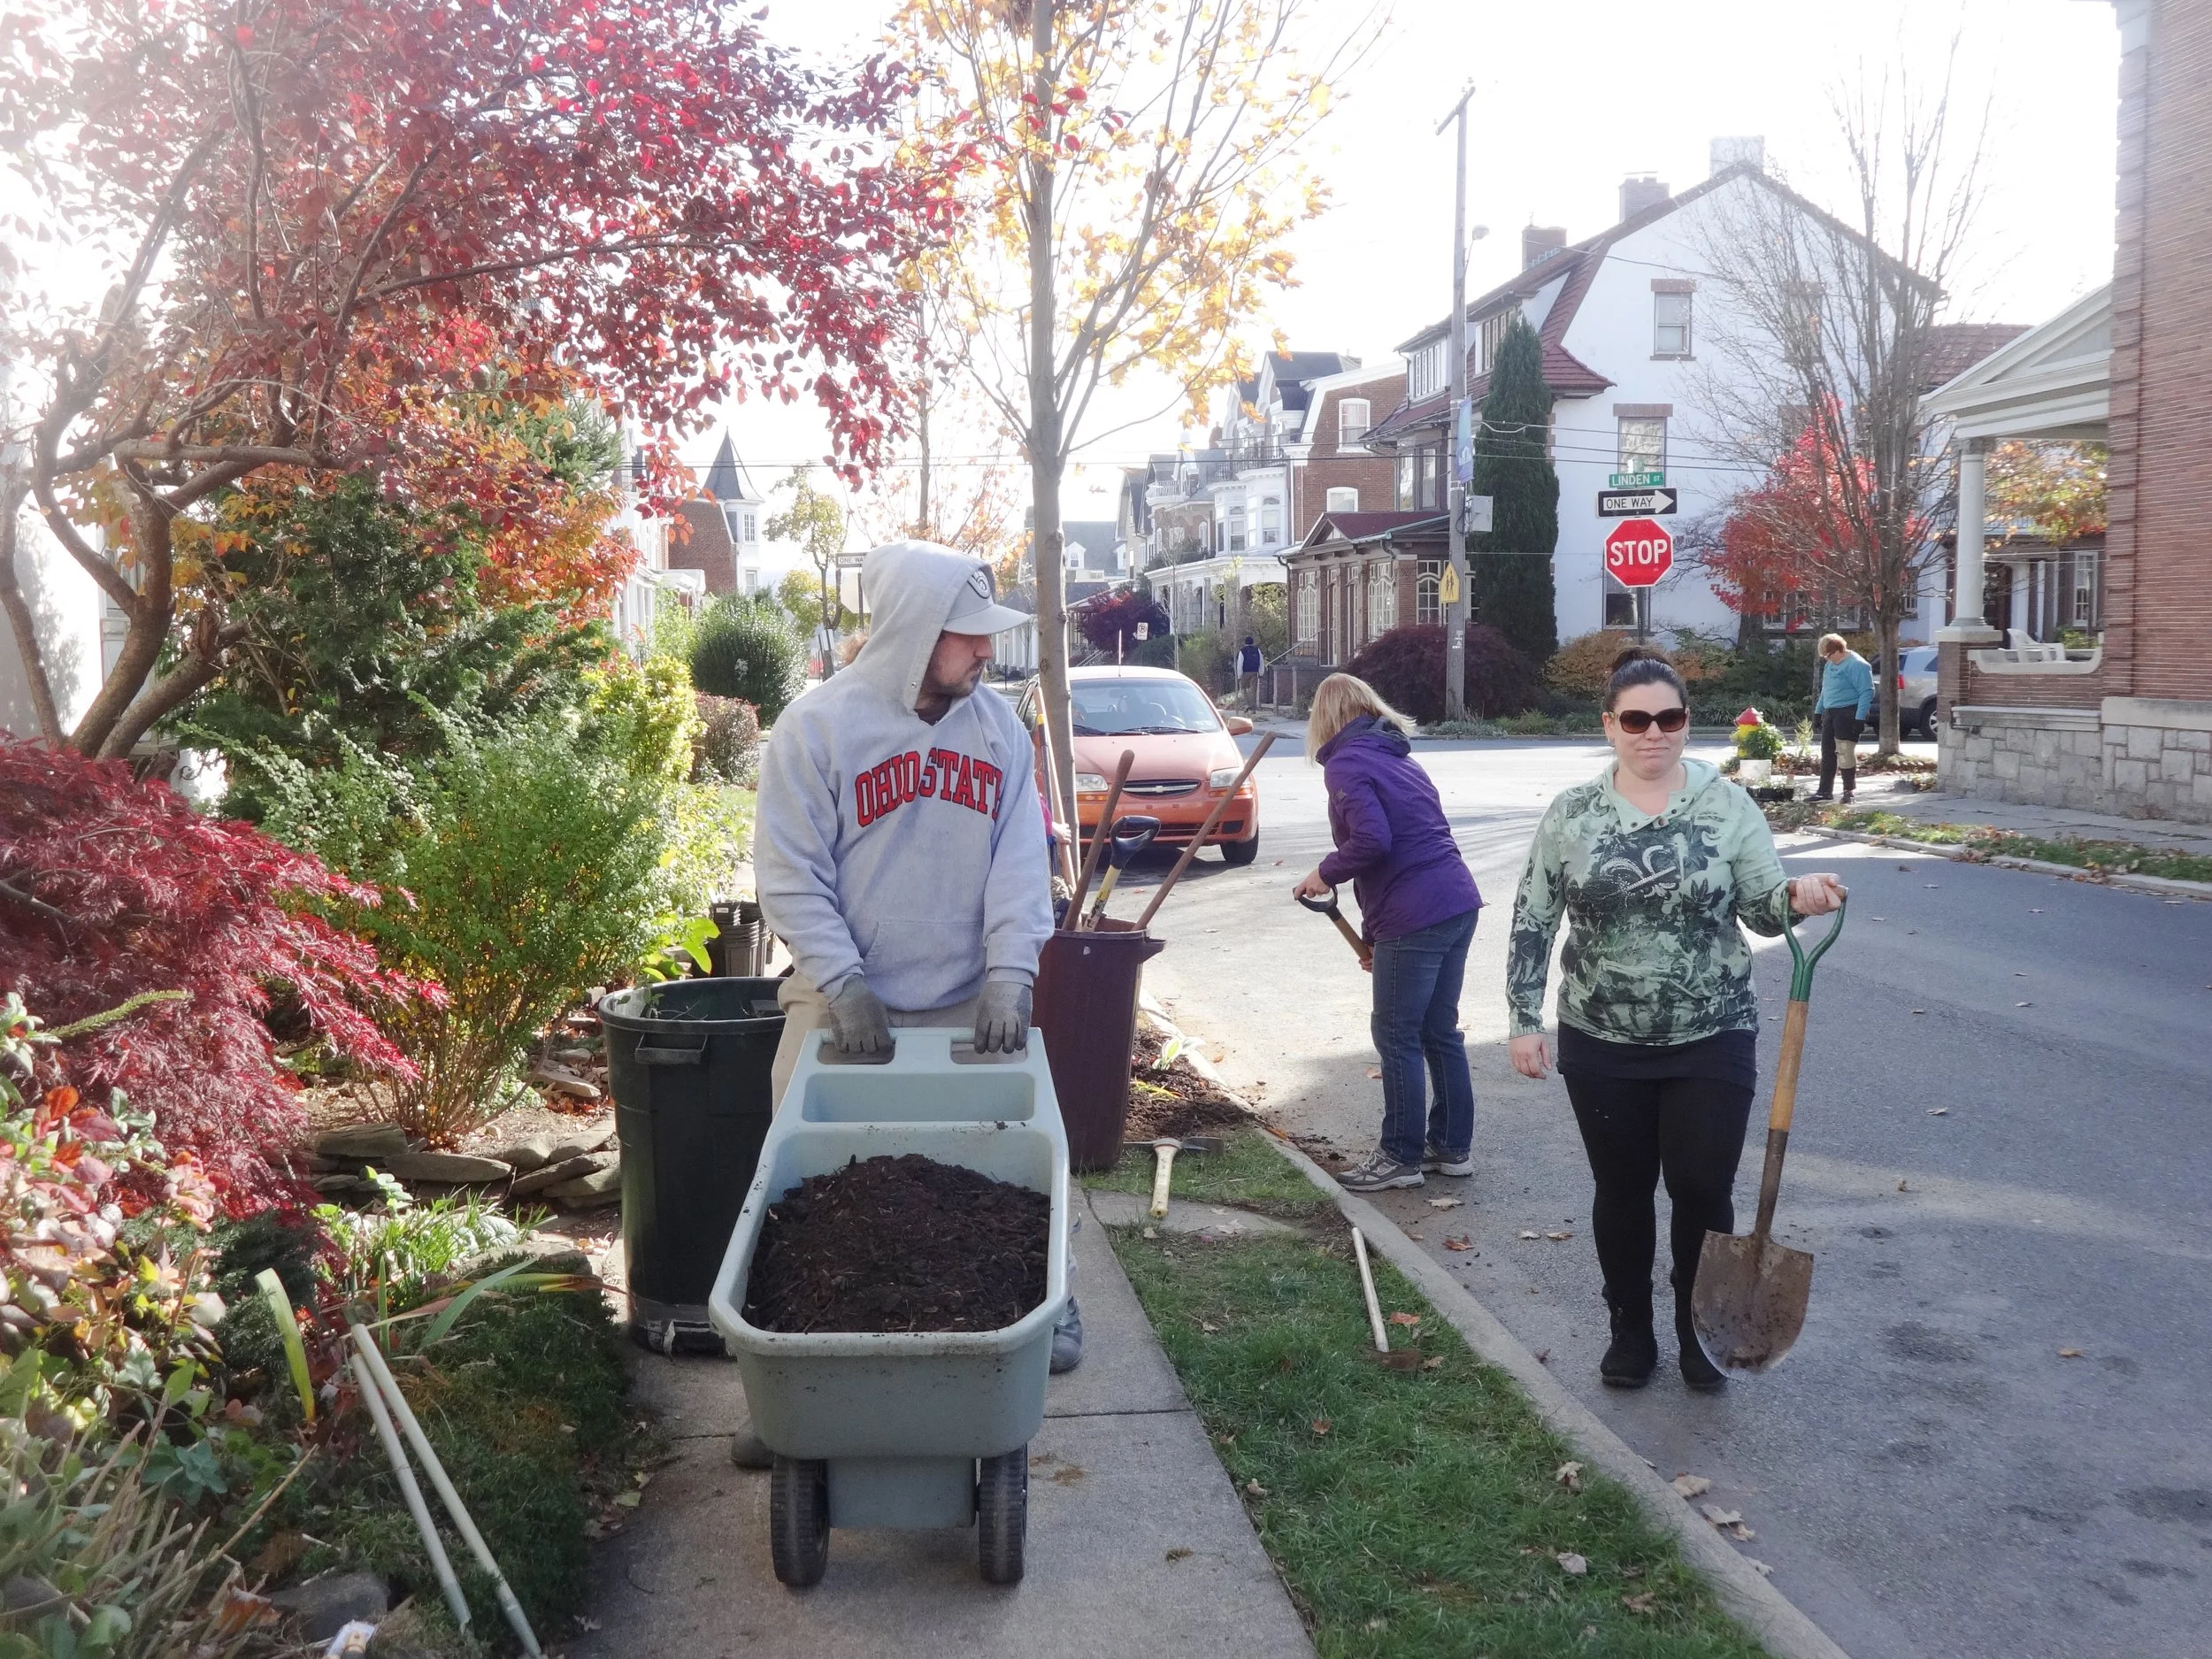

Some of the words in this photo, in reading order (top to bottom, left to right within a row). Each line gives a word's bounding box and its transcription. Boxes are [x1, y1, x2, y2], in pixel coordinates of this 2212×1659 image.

[1612, 473, 1650, 486] LINDEN
[1606, 498, 1627, 509] ONE
[1632, 496, 1654, 508] WAY
[1609, 539, 1668, 566] STOP
[855, 750, 921, 827] OHIO
